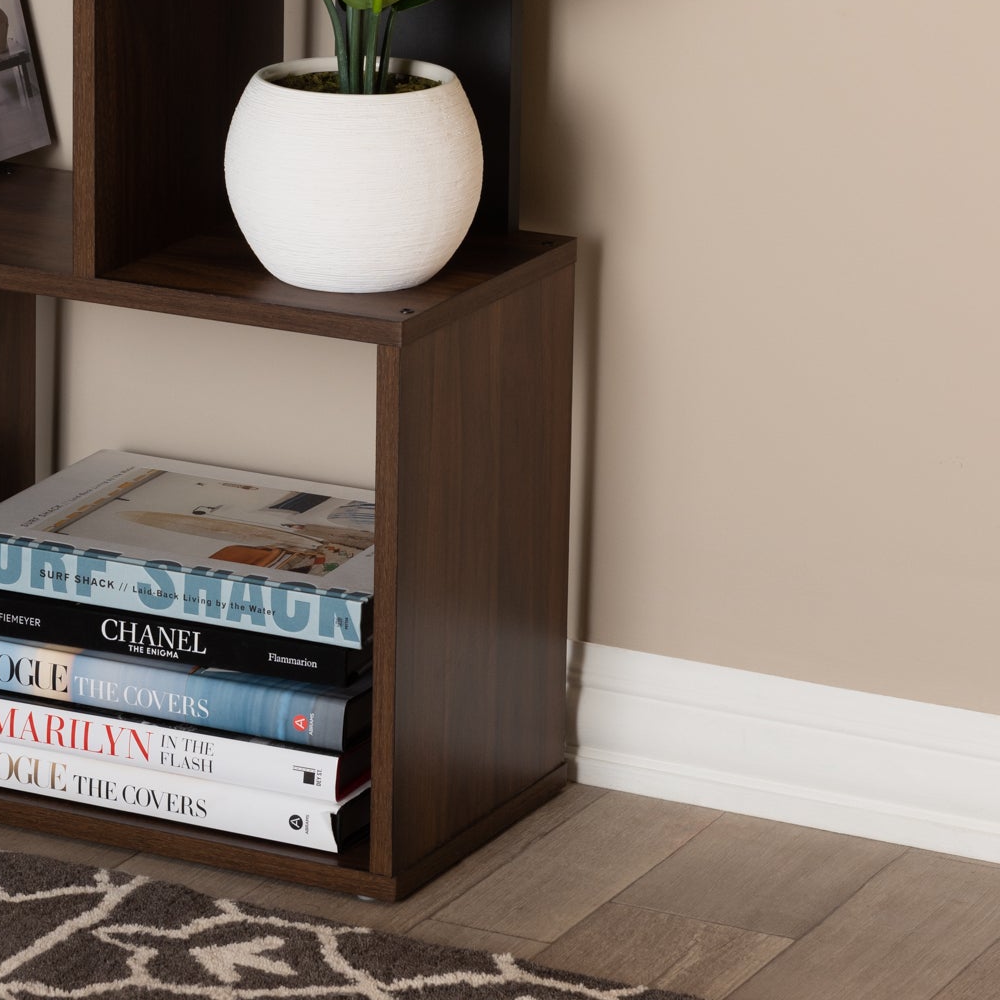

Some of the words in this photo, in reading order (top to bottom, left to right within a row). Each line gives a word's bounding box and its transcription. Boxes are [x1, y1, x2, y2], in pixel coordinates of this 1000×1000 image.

[39, 569, 70, 582] SURF
[74, 574, 115, 590] SHACK
[132, 585, 179, 600] Laid-Back
[183, 593, 212, 608] Living
[215, 600, 227, 610] by
[230, 601, 245, 612] the
[249, 604, 276, 617] Water
[137, 559, 371, 643] SHACK
[101, 618, 207, 655] CHANEL
[128, 644, 144, 654] THE
[146, 647, 179, 659] ENIGMA
[268, 652, 318, 669] Flammarion
[74, 676, 119, 704] THE
[123, 685, 209, 719] COVERS
[159, 734, 177, 749] IN
[181, 738, 215, 757] THE
[159, 750, 214, 774] FLASH
[72, 774, 118, 802] THE
[121, 783, 208, 819] COVERS
